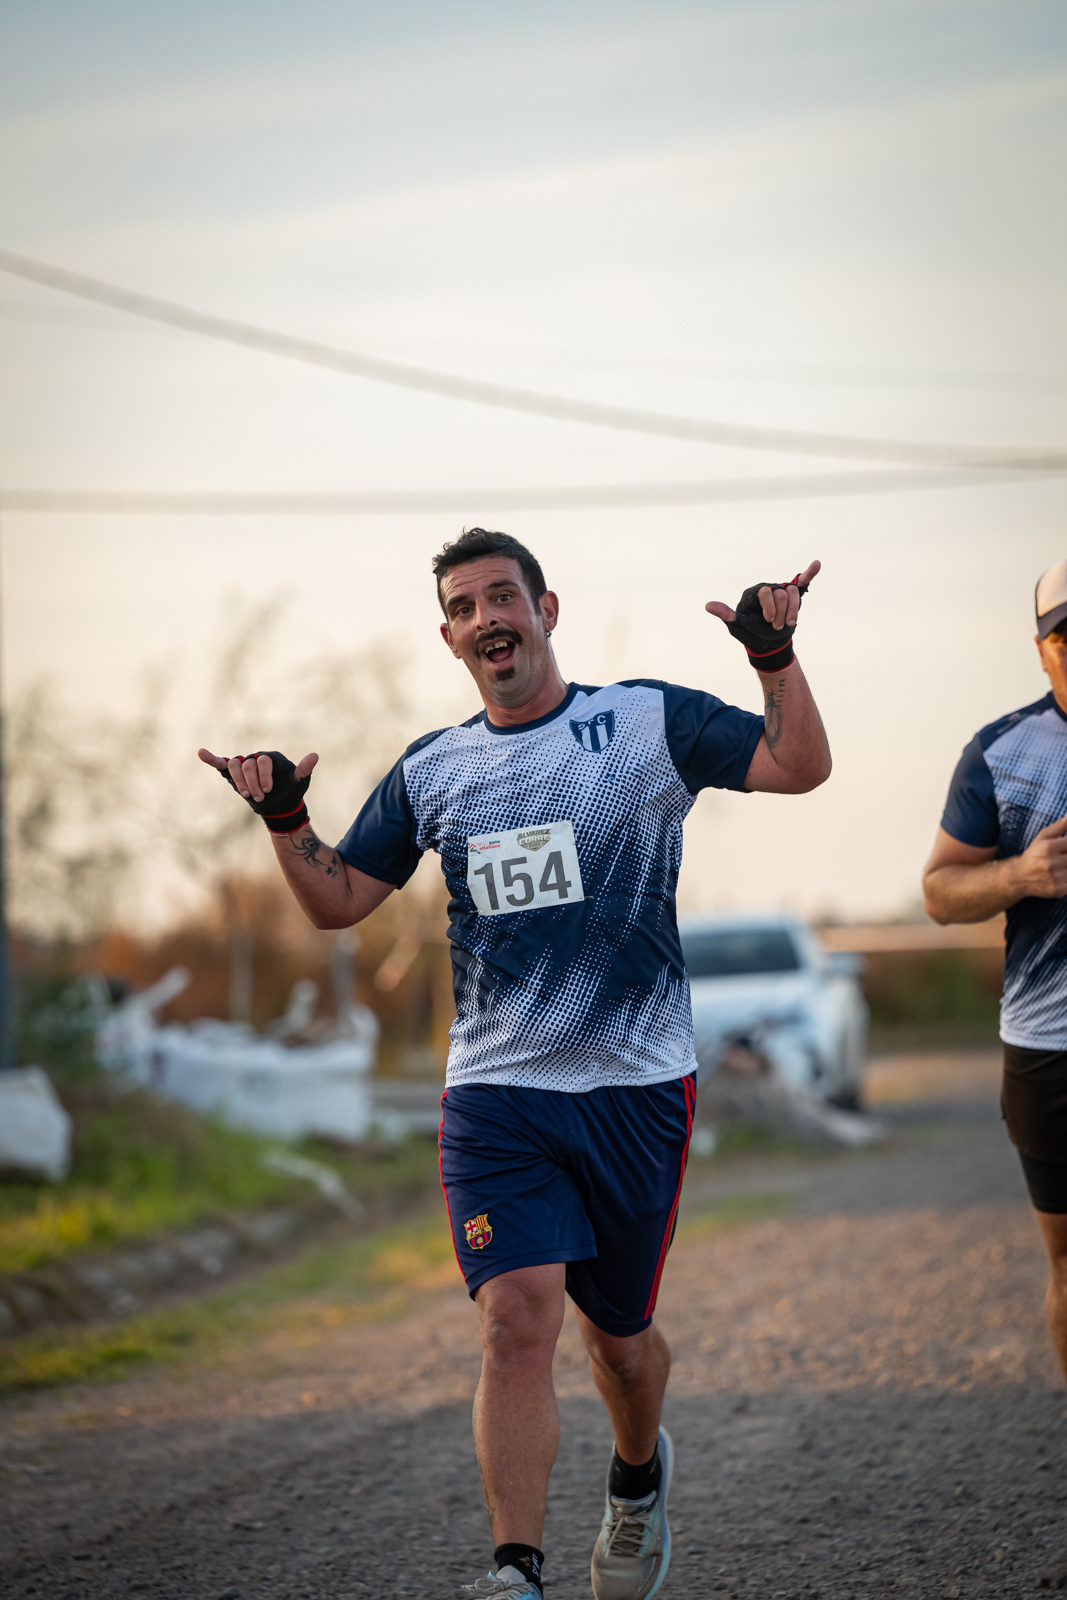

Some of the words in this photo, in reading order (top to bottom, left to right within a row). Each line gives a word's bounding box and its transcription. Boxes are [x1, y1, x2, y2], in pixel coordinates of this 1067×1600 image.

[518, 829, 551, 838] ALVAREZ
[519, 835, 550, 845] CORRE
[473, 850, 572, 911] 154
